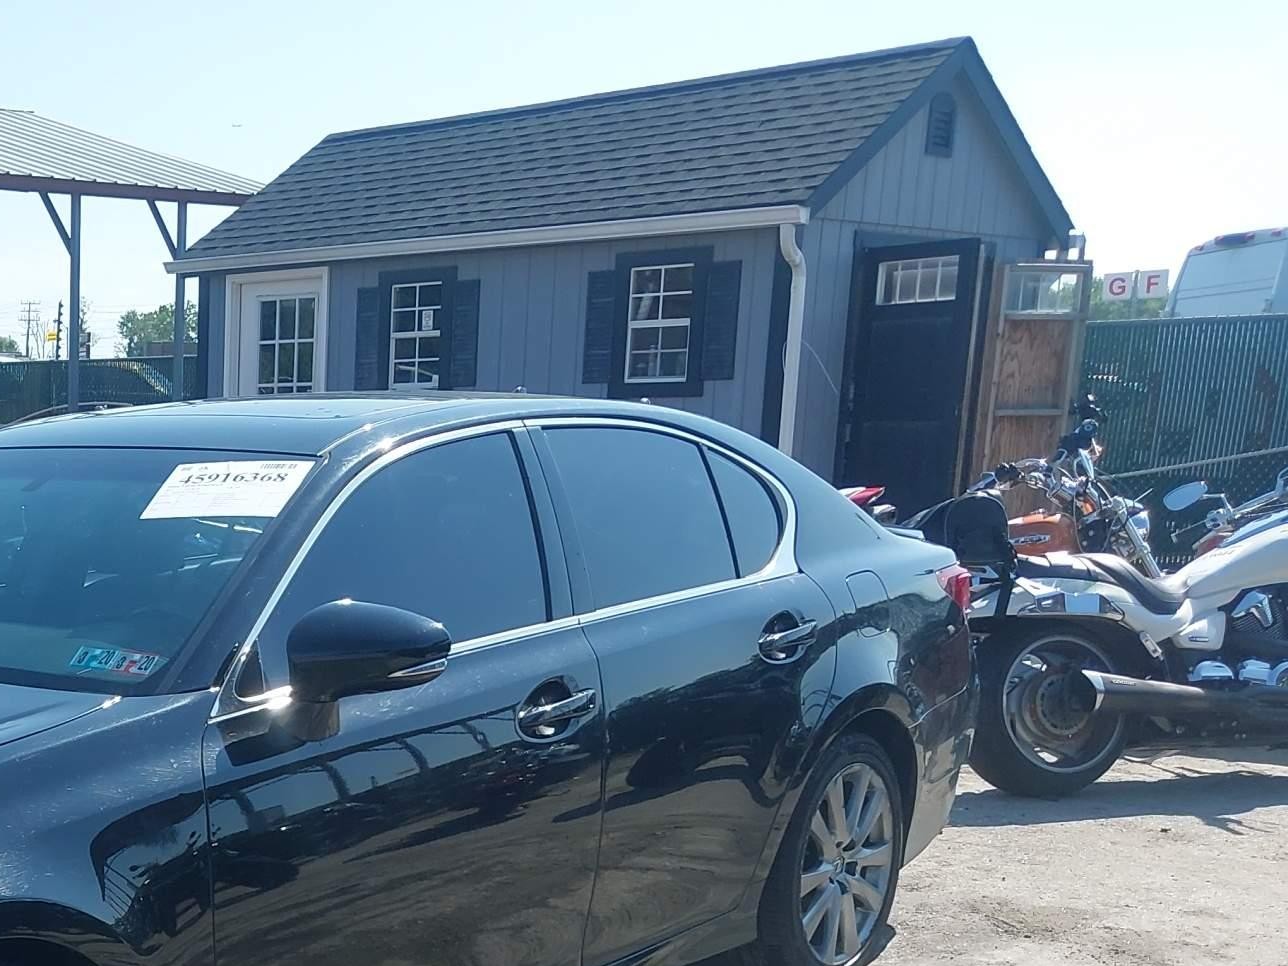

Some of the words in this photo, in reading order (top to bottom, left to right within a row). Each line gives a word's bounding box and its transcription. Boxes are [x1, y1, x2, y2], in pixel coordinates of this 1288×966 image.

[1109, 277, 1126, 296] G
[1146, 274, 1160, 293] F
[179, 472, 289, 485] 45916368
[77, 651, 88, 665] 3
[98, 650, 116, 666] 20
[116, 656, 127, 669] 3
[137, 655, 156, 671] 20
